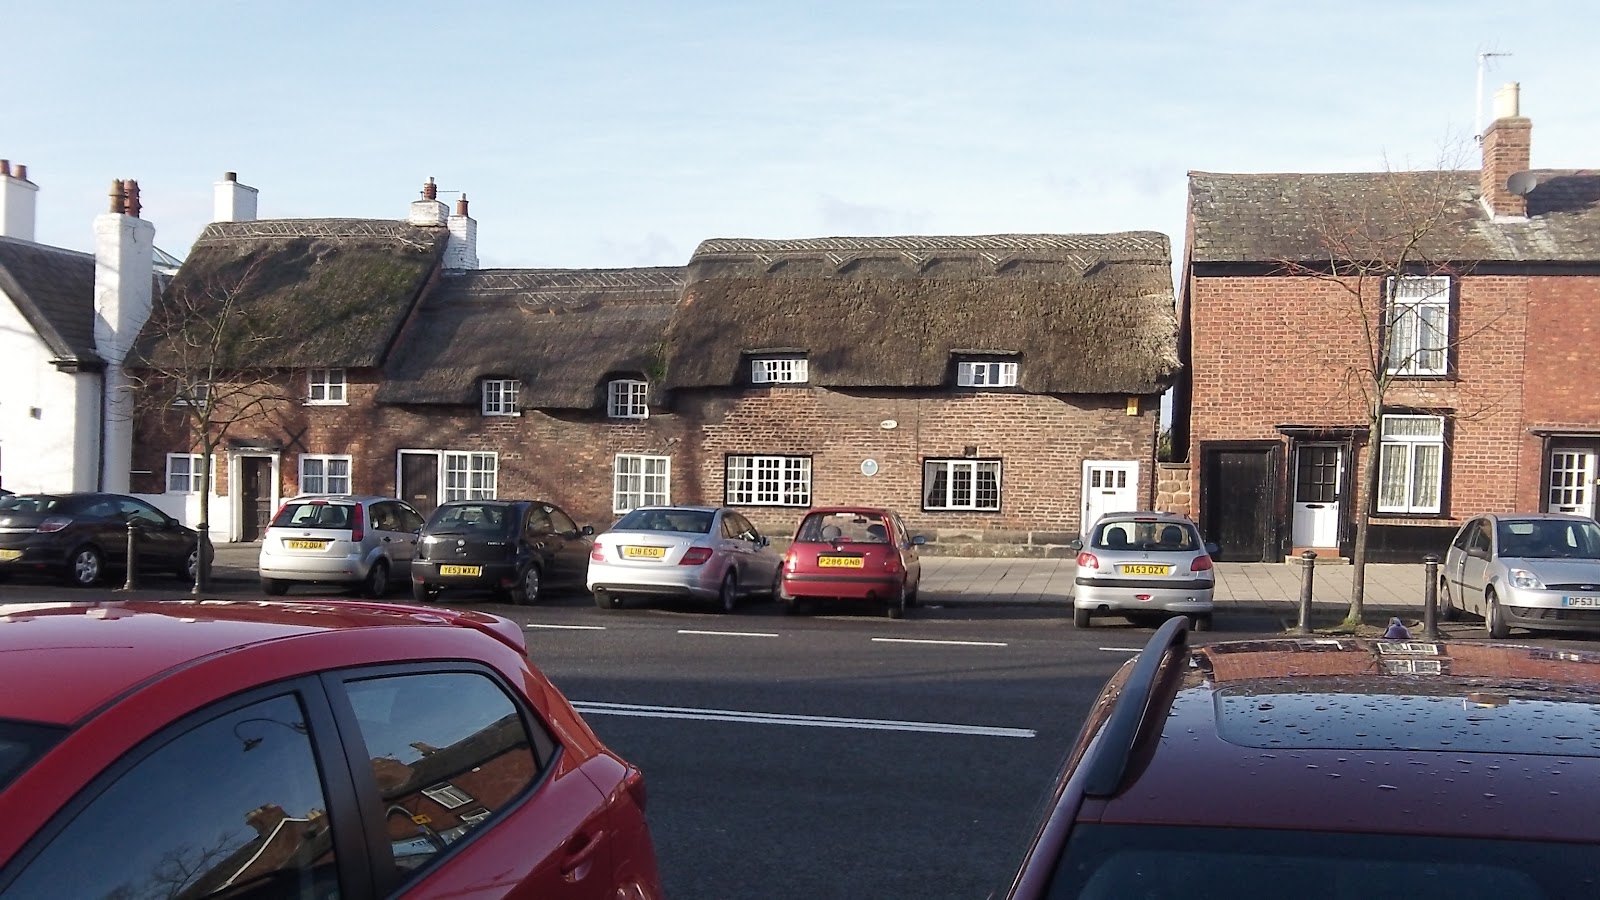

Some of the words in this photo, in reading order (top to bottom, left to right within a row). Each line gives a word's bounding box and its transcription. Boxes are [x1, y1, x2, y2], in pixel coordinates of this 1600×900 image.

[462, 567, 476, 575] WXX
[1124, 565, 1146, 574] DA53
[1568, 597, 1593, 606] DF53
